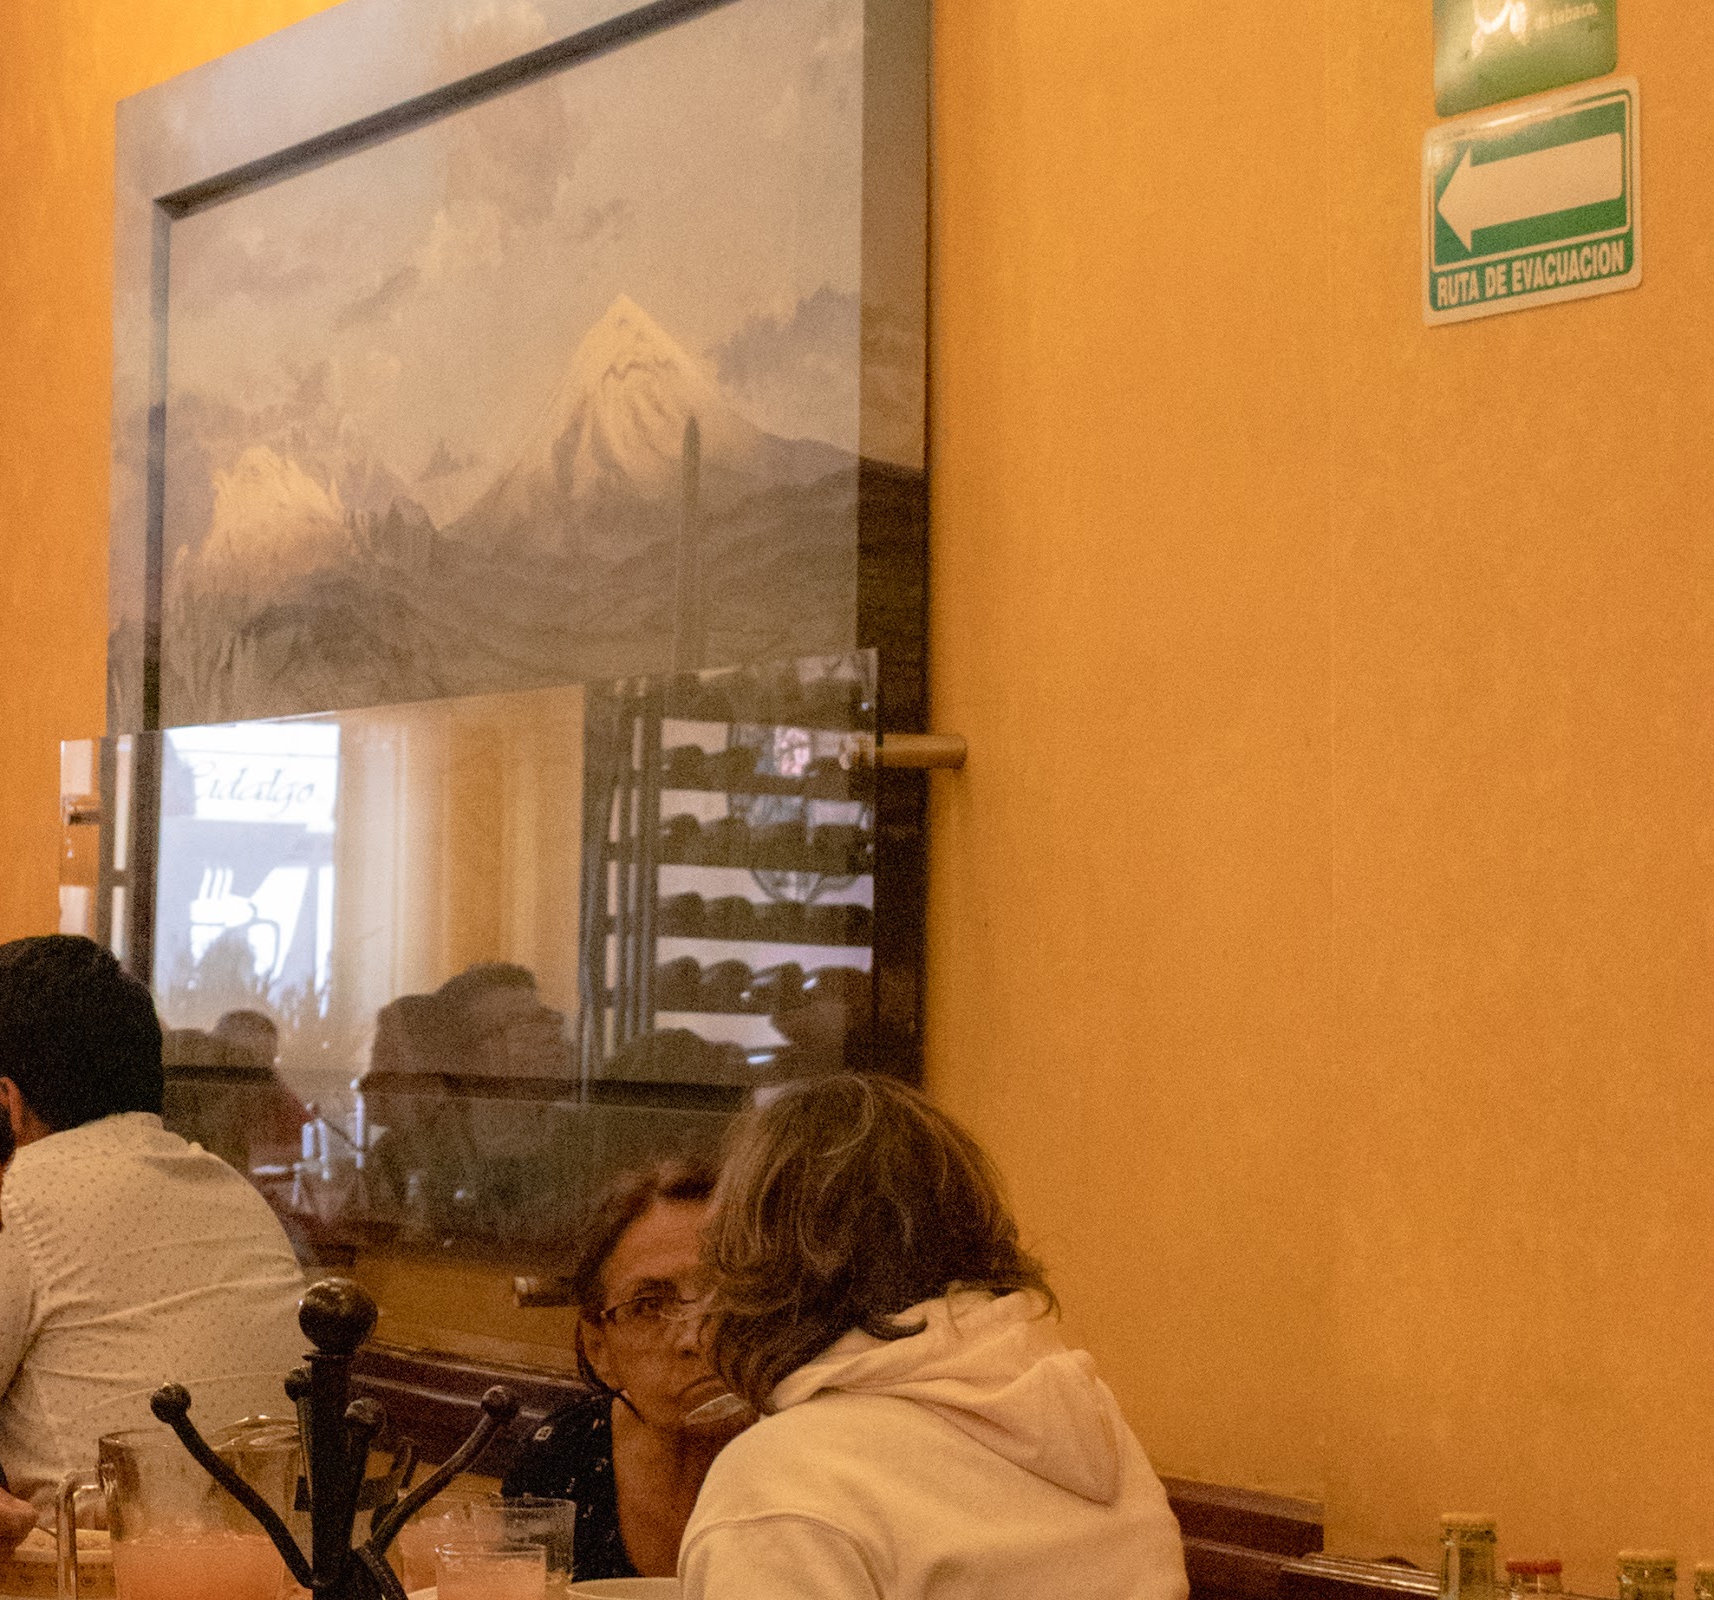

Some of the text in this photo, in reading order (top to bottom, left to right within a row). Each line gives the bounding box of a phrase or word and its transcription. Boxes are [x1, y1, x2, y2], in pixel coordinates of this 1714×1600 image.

[1436, 239, 1625, 308] RUTA DE EVACUACION
